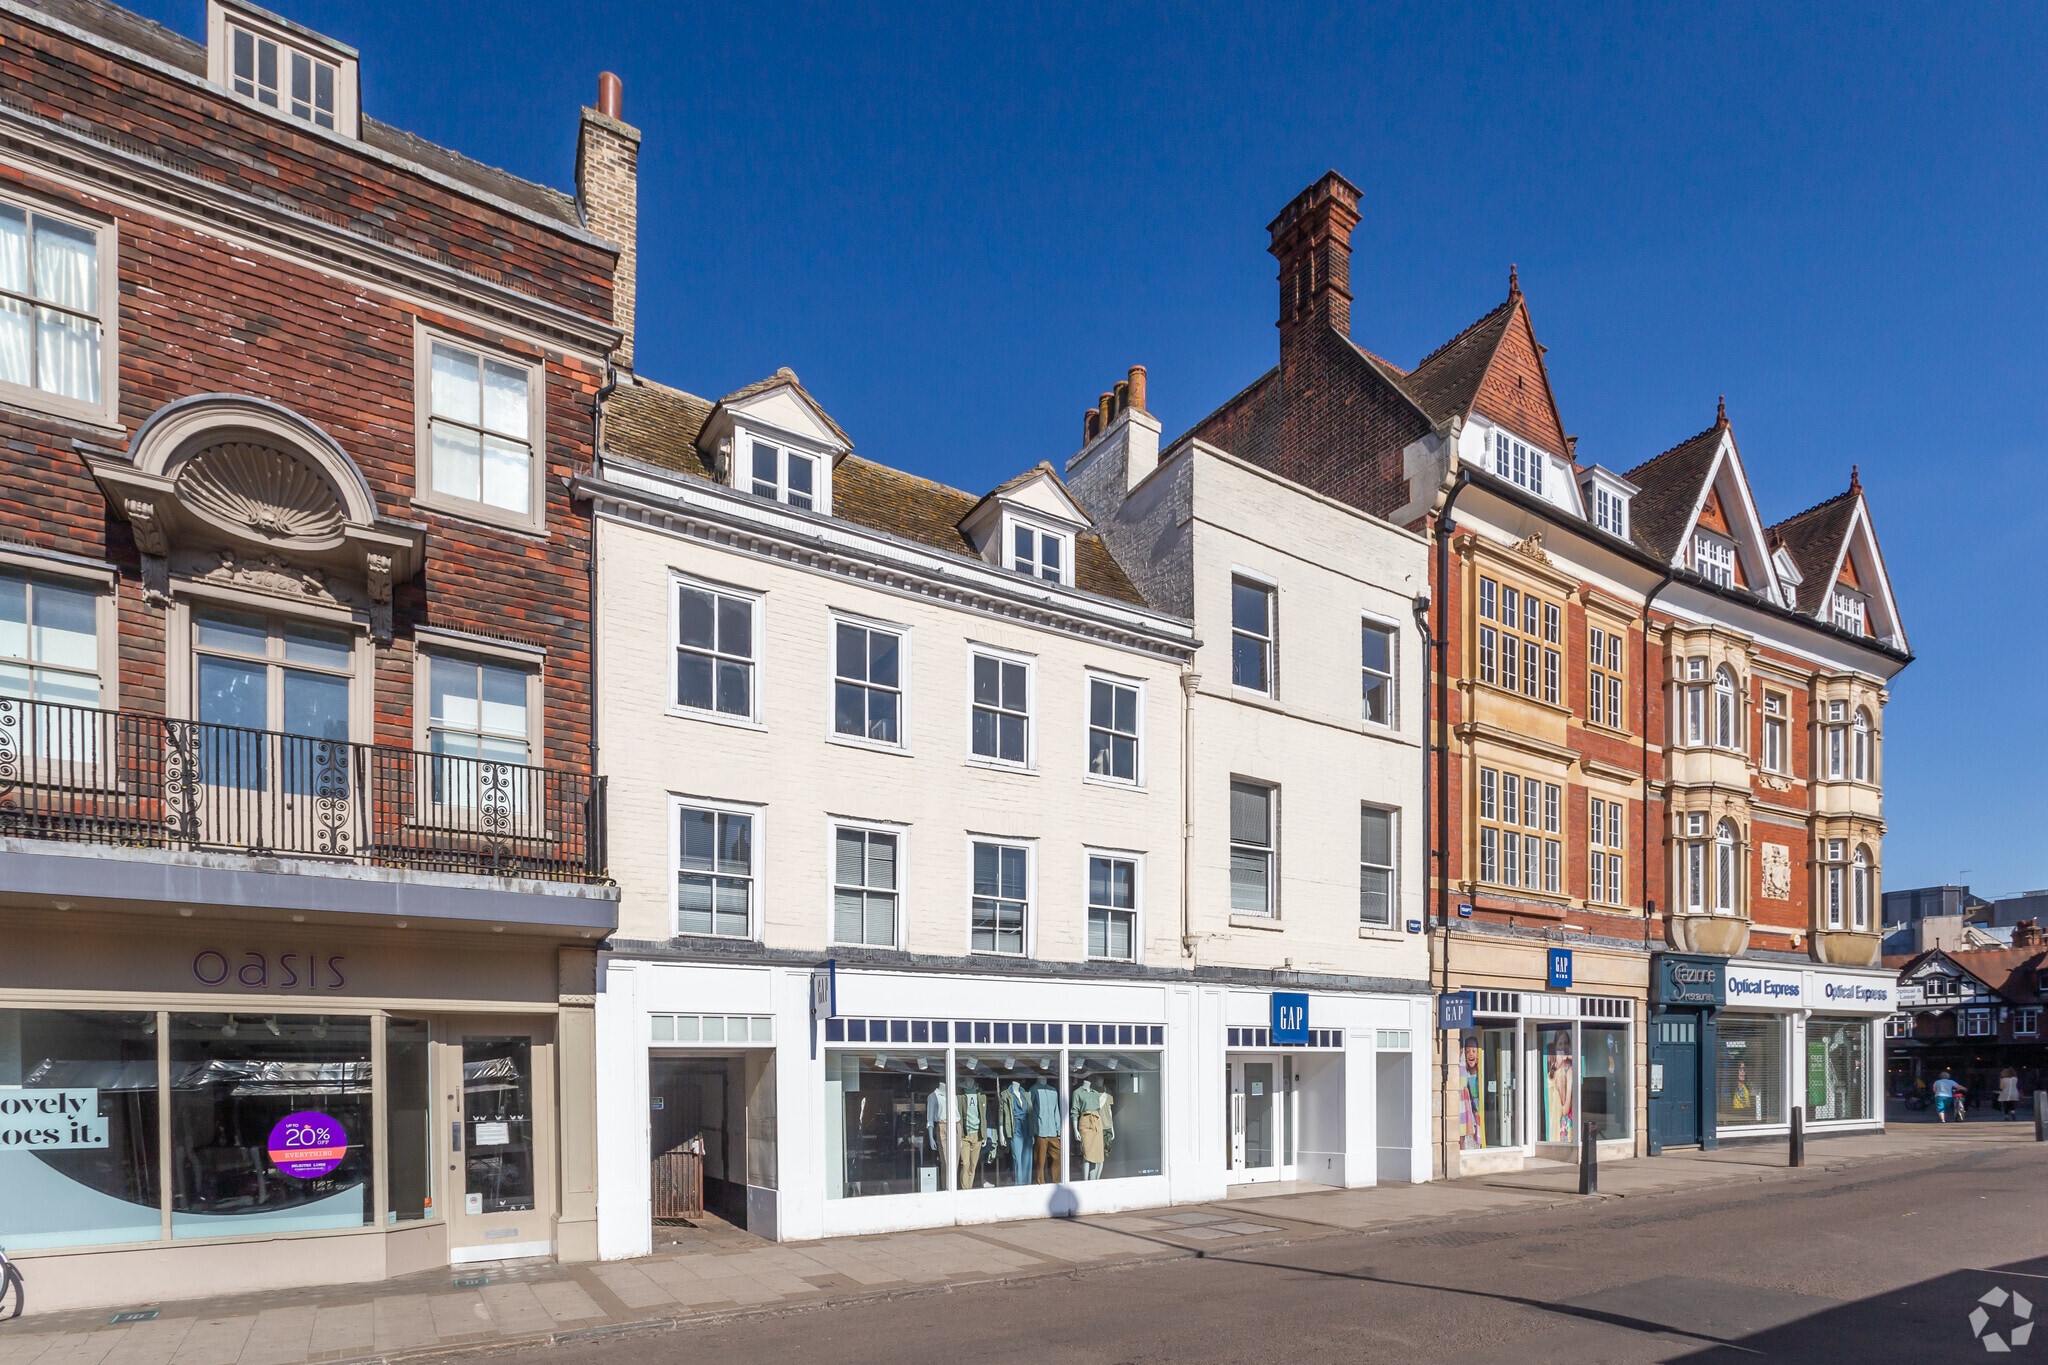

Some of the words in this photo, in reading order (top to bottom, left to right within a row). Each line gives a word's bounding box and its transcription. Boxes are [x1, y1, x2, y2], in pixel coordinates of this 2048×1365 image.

[1555, 956, 1568, 973] GAP
[1728, 976, 1762, 996] Optical
[1764, 980, 1800, 998] Express
[1825, 983, 1854, 1001] Optical
[1856, 985, 1887, 1003] Express
[1280, 1006, 1303, 1030] GAP
[1445, 1005, 1463, 1021] GAP
[0, 1092, 88, 1120] ovely
[0, 1128, 60, 1145] oes
[70, 1121, 102, 1143] it.
[286, 1128, 330, 1146] 20%
[284, 1150, 332, 1159] EVERYTHING
